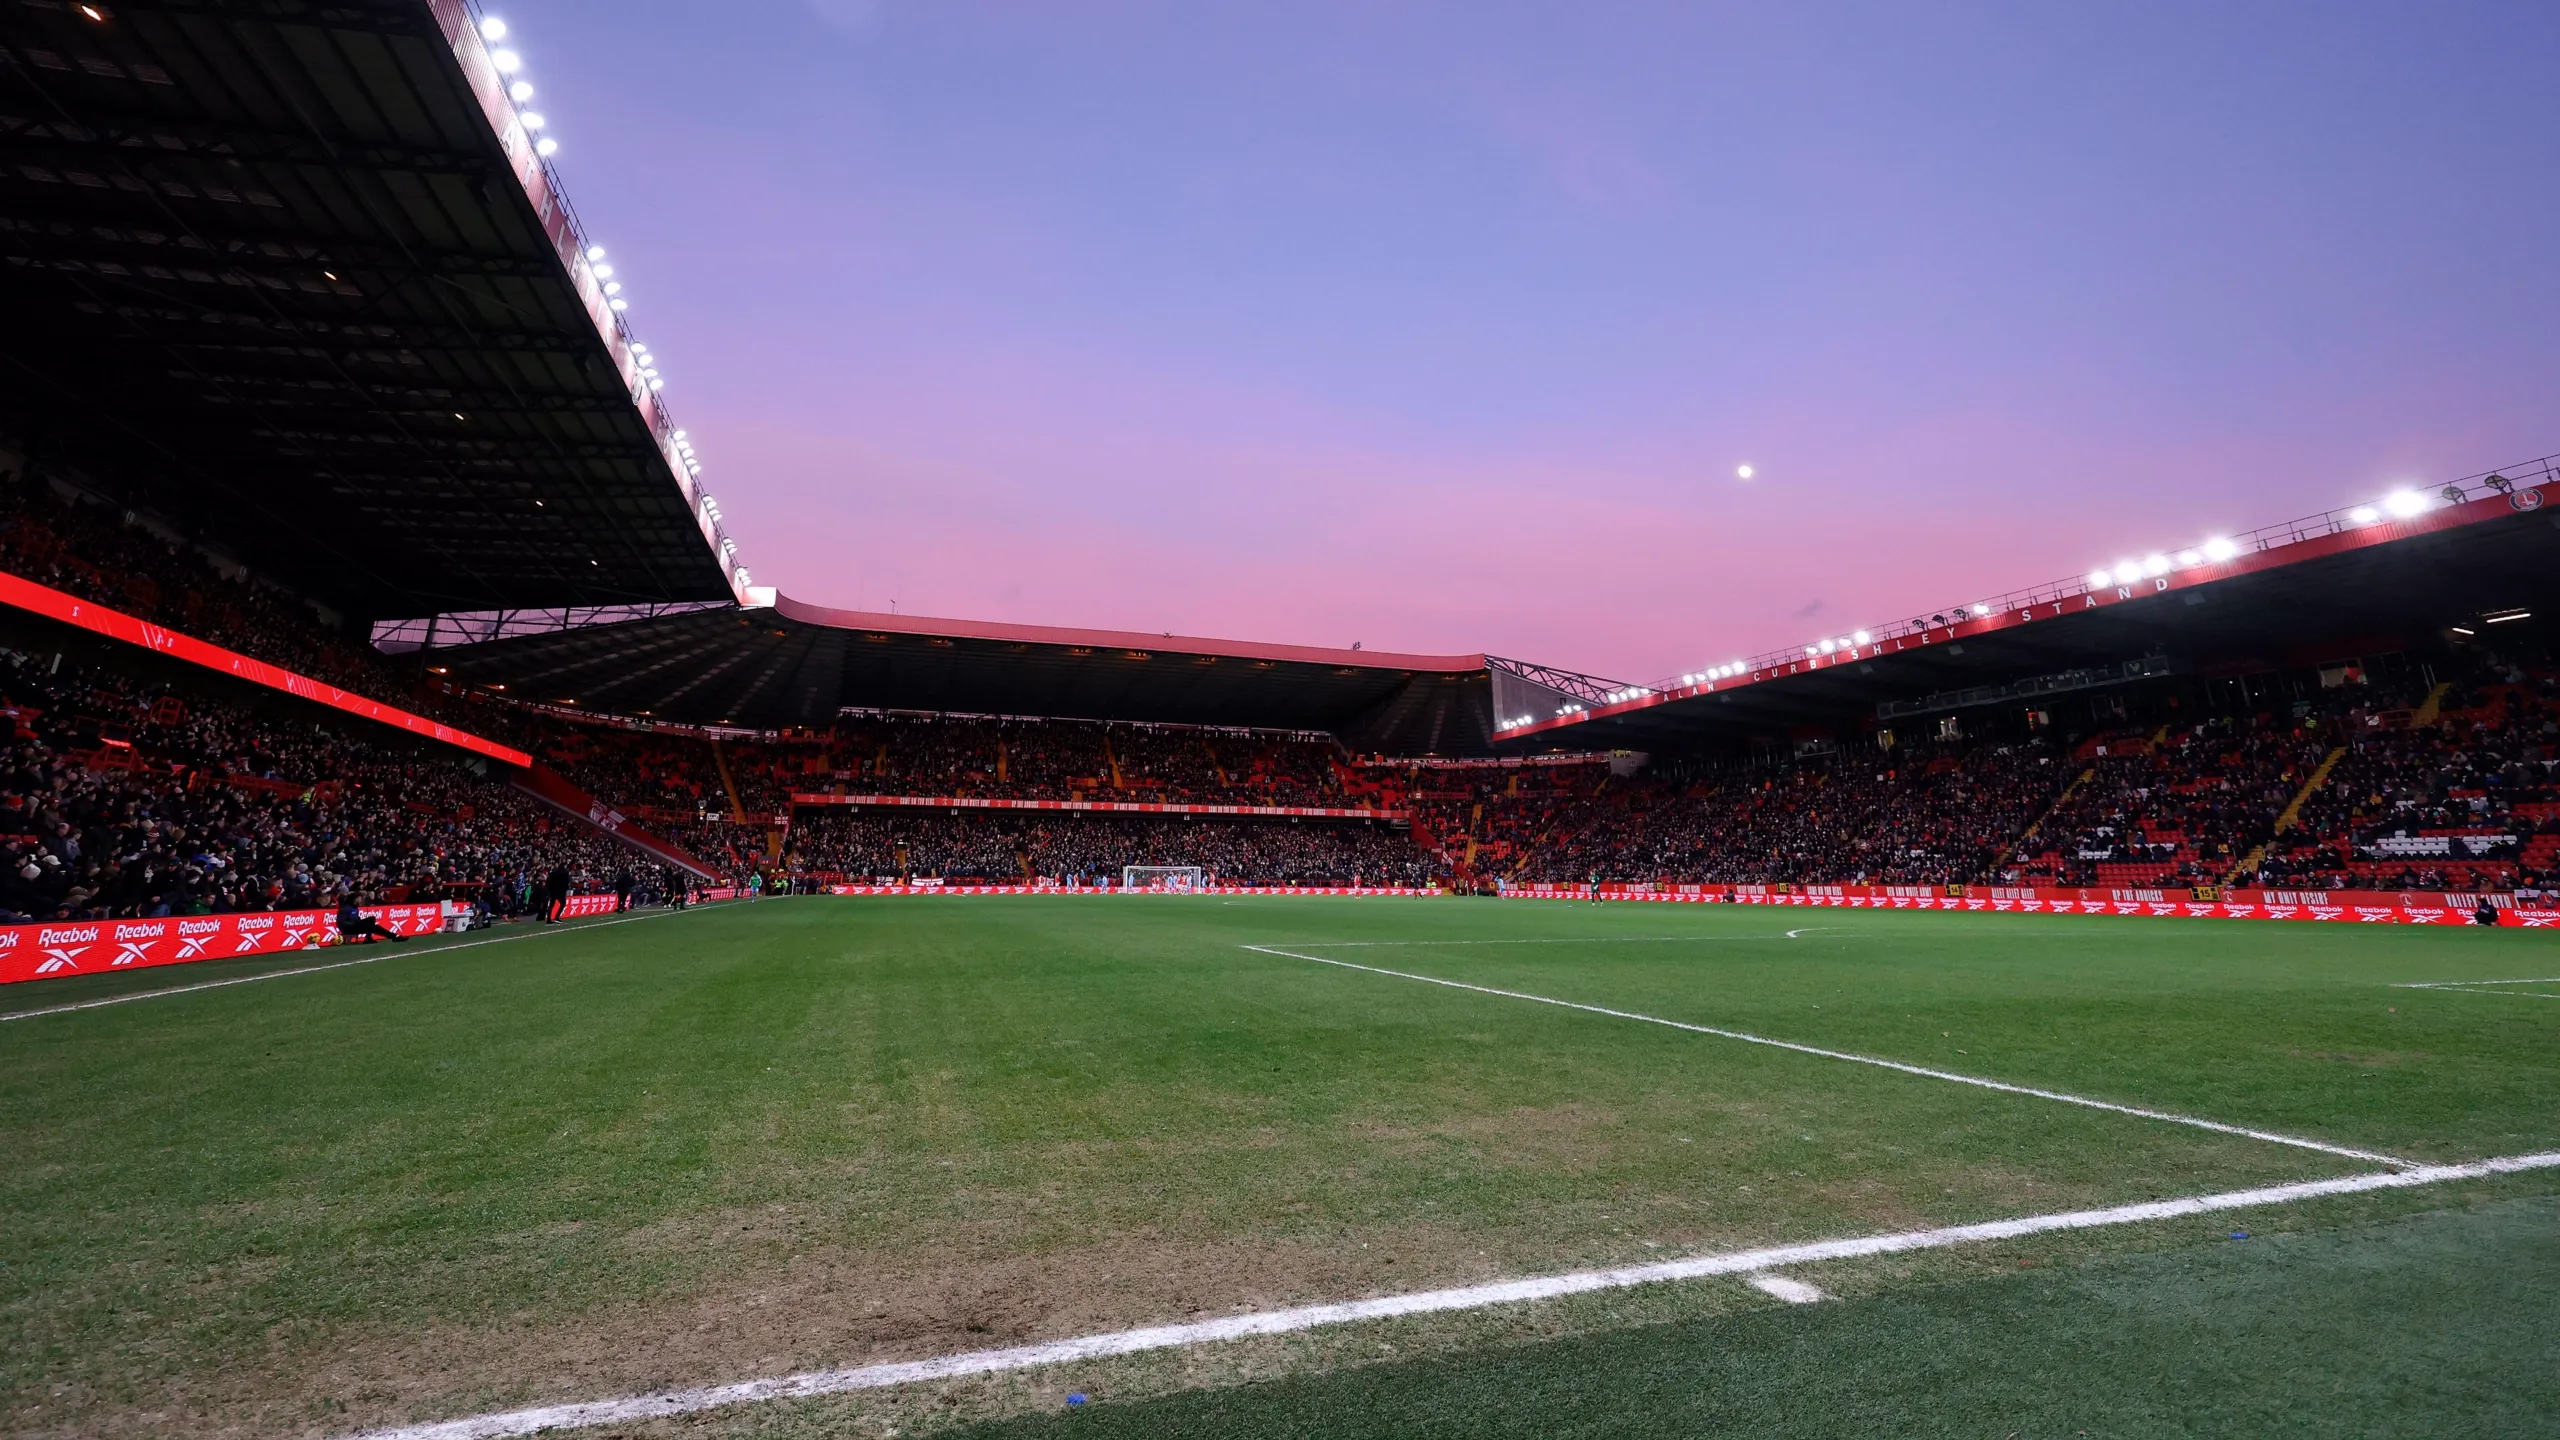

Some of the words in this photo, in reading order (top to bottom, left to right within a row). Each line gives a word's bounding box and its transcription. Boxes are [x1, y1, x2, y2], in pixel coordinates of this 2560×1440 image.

[1663, 683, 1715, 702] ALAN
[1754, 628, 1955, 682] CURBISHLEY
[2022, 578, 2168, 622] STAND
[2112, 889, 2121, 900] UP
[2200, 890, 2210, 898] 15
[2263, 891, 2276, 903] MY
[2300, 892, 2329, 904] DESIRE
[2224, 903, 2255, 911] Reebok
[2264, 904, 2298, 912] Reebok
[2308, 905, 2344, 913] Reebok
[2514, 910, 2560, 918] Reebok
[38, 926, 99, 947] Reebok
[114, 922, 165, 941] Reebok
[178, 919, 221, 936] Reebok
[237, 915, 275, 932] Reebok
[283, 912, 315, 928] Reebok
[323, 912, 337, 925] Ree
[389, 906, 412, 919] Reebok
[416, 905, 437, 917] Reebok
